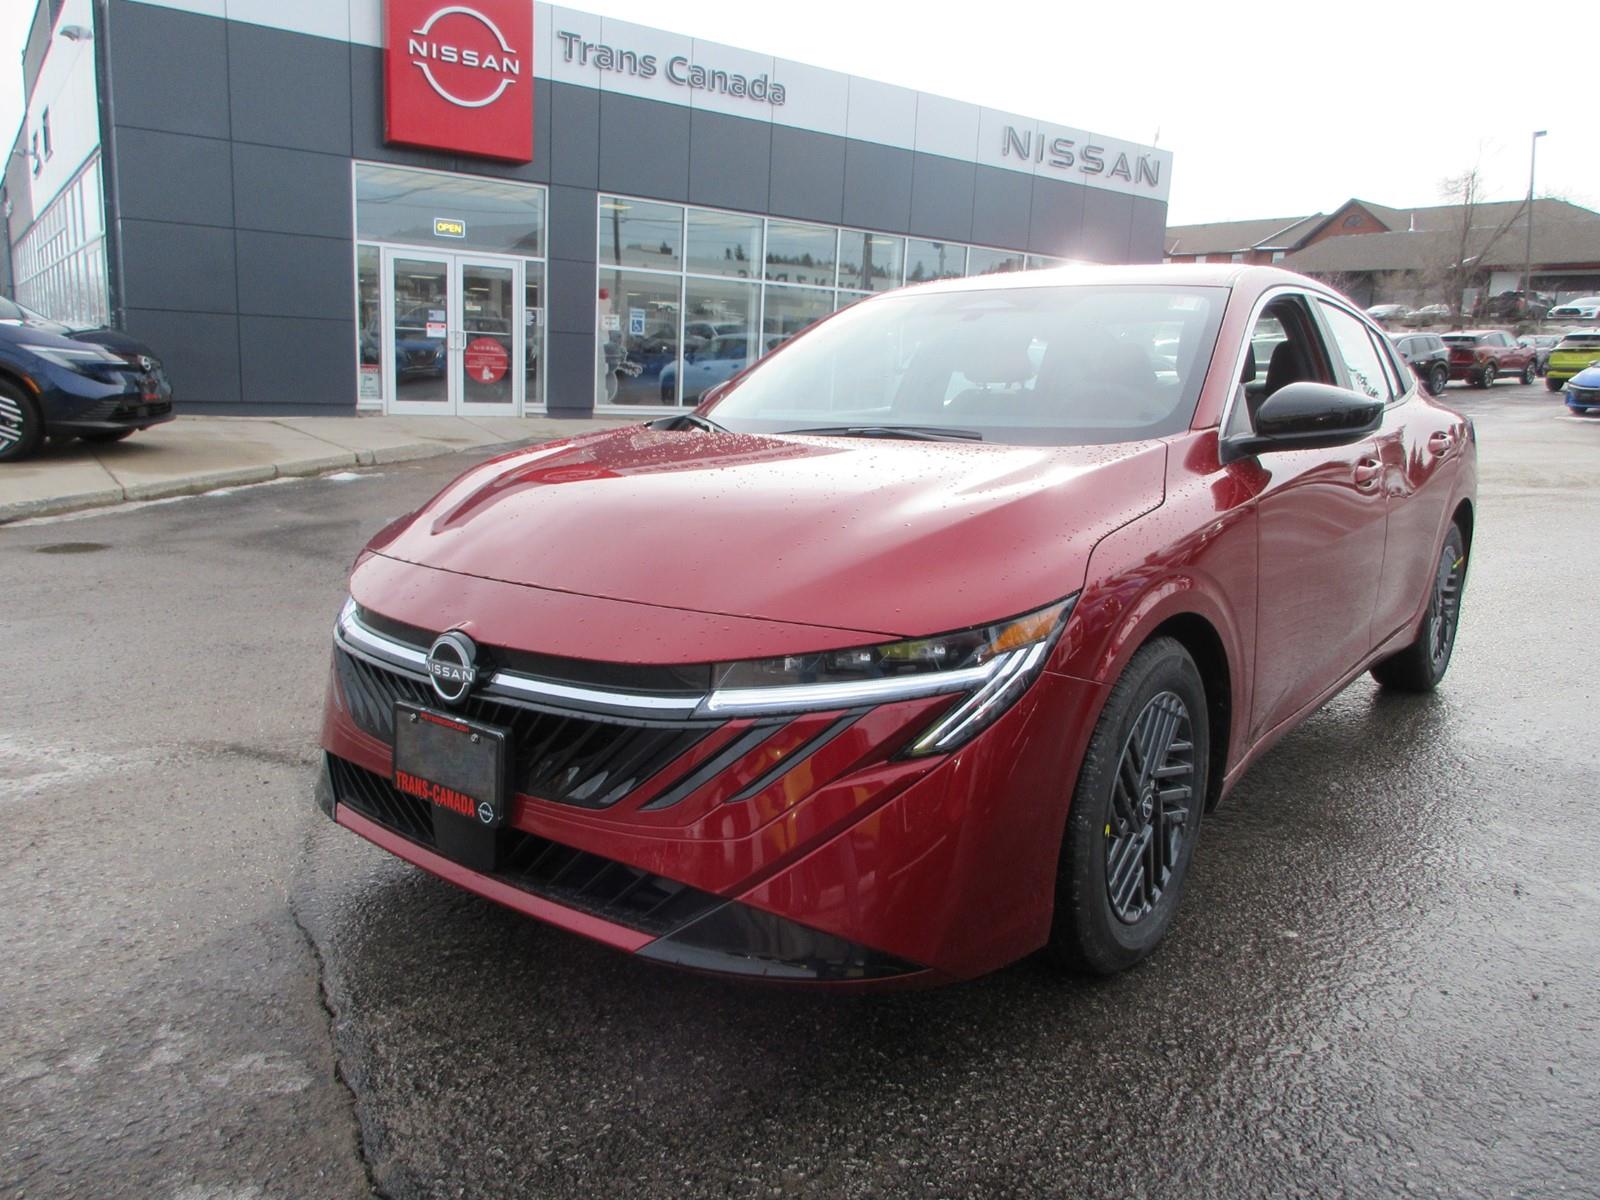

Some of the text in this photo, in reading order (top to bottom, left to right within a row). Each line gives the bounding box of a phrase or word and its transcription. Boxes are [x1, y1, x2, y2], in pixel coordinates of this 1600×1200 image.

[408, 39, 519, 75] NISSAN
[558, 30, 787, 106] Trans Canada
[1002, 125, 1160, 188] NISSAN
[437, 222, 462, 233] OPEN
[425, 660, 473, 681] NISSAN
[395, 770, 475, 817] TRANS-CANADA
